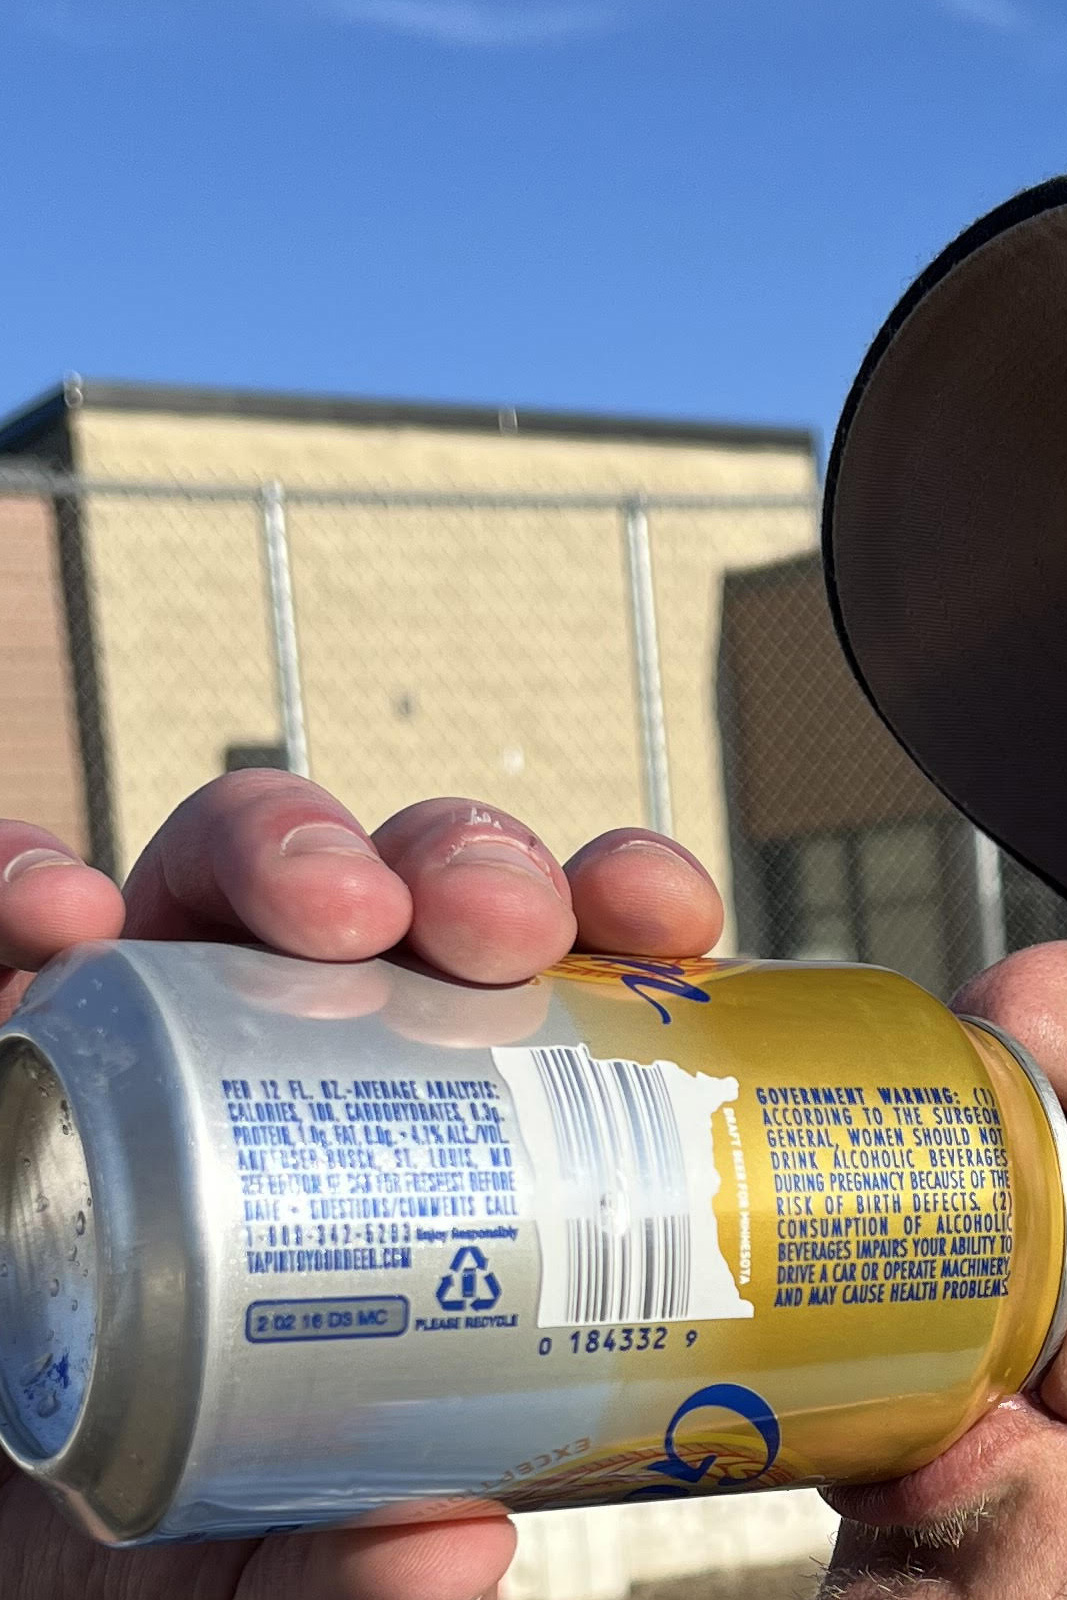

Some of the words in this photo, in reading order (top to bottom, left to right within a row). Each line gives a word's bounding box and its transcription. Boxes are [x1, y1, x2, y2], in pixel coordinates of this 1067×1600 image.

[261, 1080, 281, 1100] 12
[288, 1080, 314, 1100] FL.
[426, 1080, 500, 1100] ANALYSIS:
[755, 1086, 865, 1106] GOVERNMENT
[877, 1086, 961, 1105] WARNING:
[762, 1107, 852, 1127] ACCORDING
[863, 1107, 883, 1126] TO
[896, 1107, 924, 1125] THE
[934, 1107, 1001, 1125] SURGEON
[767, 1129, 840, 1150] GENERAL,
[847, 1128, 904, 1148] WOMEN
[913, 1128, 971, 1146] SHOULD
[979, 1127, 1005, 1145] NOT
[771, 1150, 818, 1170] DRINK
[833, 1149, 914, 1169] ALCOHOLIC
[930, 1149, 1009, 1167] BEVERAGES
[774, 1173, 824, 1193] DURING
[829, 1171, 904, 1192] PREGNANCY
[910, 1171, 965, 1190] BECAUSE
[970, 1170, 986, 1188] OF
[989, 1169, 1011, 1188] THE
[485, 1195, 519, 1216] CALL
[776, 1196, 813, 1216] RISK
[825, 1195, 844, 1214] OF
[856, 1193, 901, 1214] BIRTH
[912, 1192, 981, 1213] DEFECTS.
[992, 1191, 1013, 1211] (2)
[777, 1217, 889, 1239] CONSUMPTION
[903, 1215, 923, 1236] OF
[936, 1213, 1013, 1235] ALCOHOLIC
[777, 1240, 851, 1262] BEVERAGES
[856, 1238, 908, 1259] IMPAIRS
[912, 1237, 947, 1257] YOUR
[949, 1236, 996, 1255] ABILITY
[999, 1234, 1013, 1254] TO
[777, 1263, 815, 1285] DRIVE
[819, 1263, 829, 1283] A
[832, 1262, 857, 1282] CAR
[861, 1261, 878, 1281] OR
[883, 1259, 937, 1281] OPERATE
[940, 1256, 1012, 1278] MACHINERY,
[774, 1286, 803, 1308] AND
[807, 1285, 838, 1306] MAY
[842, 1283, 884, 1304] CAUSE
[890, 1281, 938, 1302] HEALTH
[256, 1315, 269, 1333] 2
[415, 1316, 462, 1331] PLEASE
[465, 1313, 520, 1329] RECYCLE
[538, 1337, 553, 1356] 0
[571, 1328, 667, 1354] 184332
[684, 1330, 698, 1349] 9
